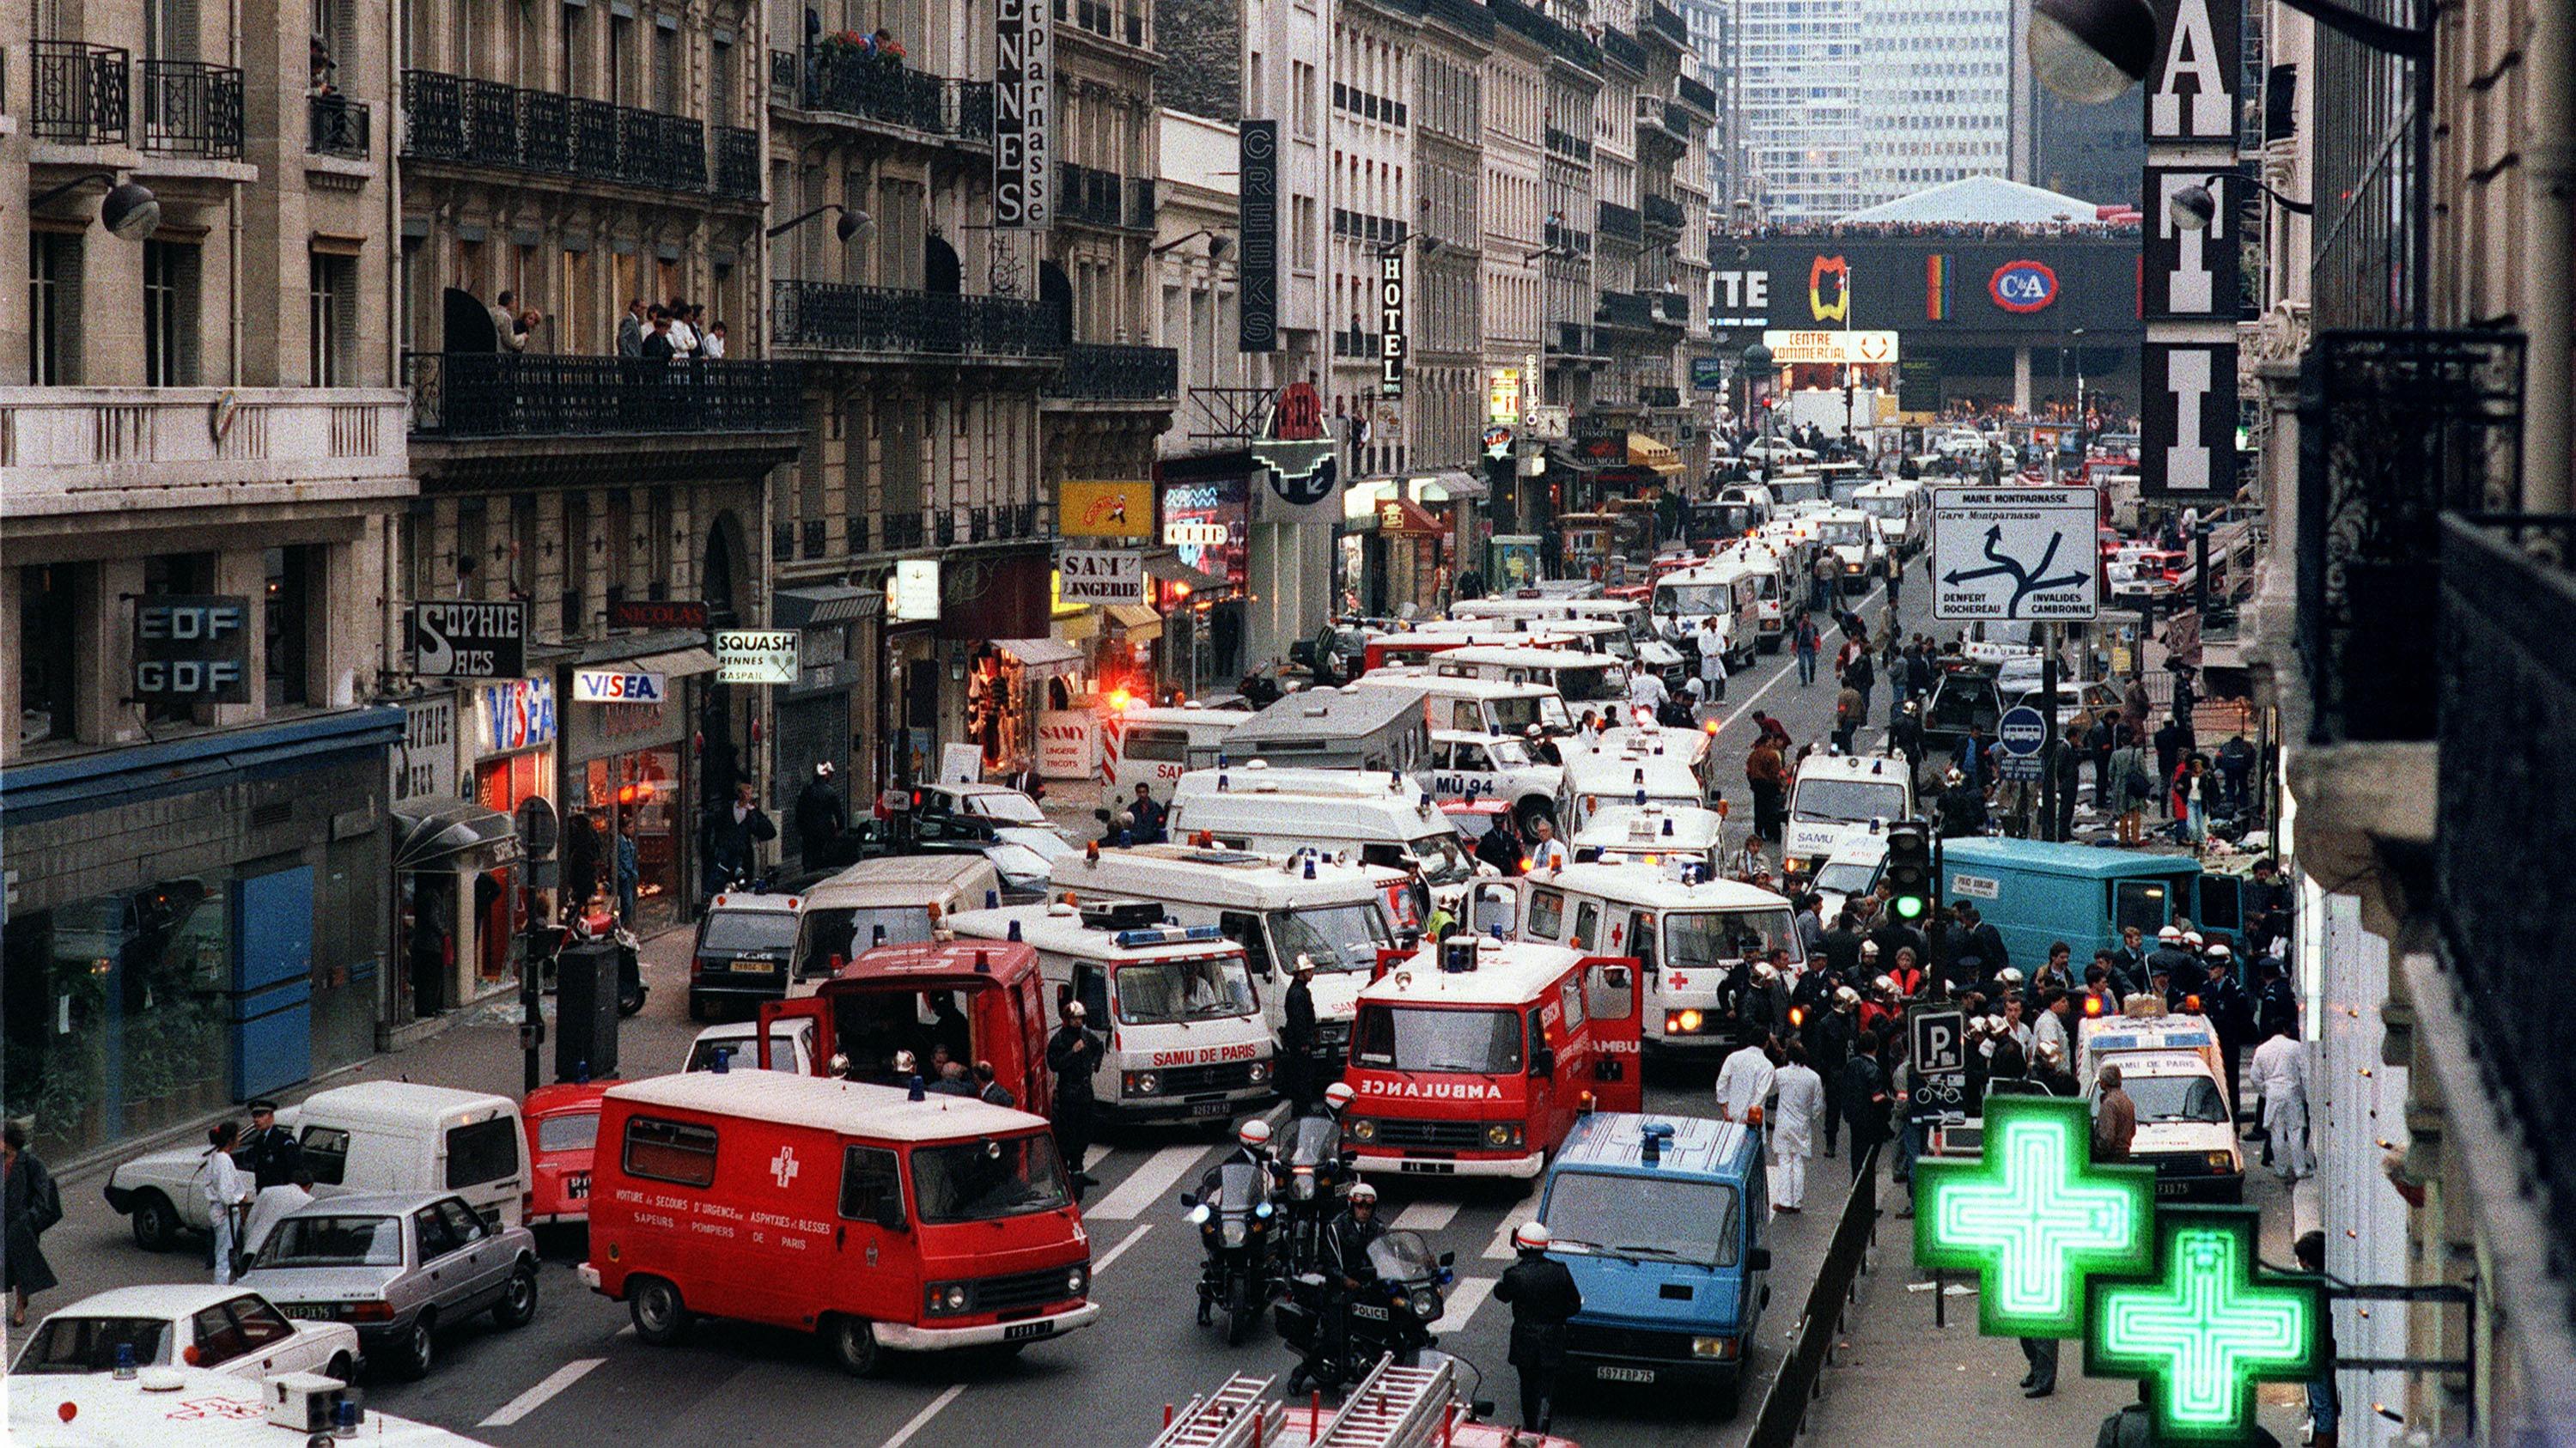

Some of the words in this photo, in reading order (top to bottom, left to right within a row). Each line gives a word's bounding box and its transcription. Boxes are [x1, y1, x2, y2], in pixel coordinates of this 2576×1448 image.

[1244, 130, 1273, 344] CREEKS
[2000, 275, 2046, 298] C&A
[1384, 259, 1401, 381] HOTEL
[1789, 332, 1832, 345] CENTRE
[1772, 346, 1847, 359] COMMERCIAL
[1962, 494, 1992, 504] MAINE
[1994, 494, 2068, 504] MONTPARNASSE
[1938, 510, 1964, 520] Gare
[1969, 510, 2041, 521] Montparnasse
[1064, 581, 1139, 597] LINGERIE
[1944, 593, 1986, 603] DENFERT
[2033, 593, 2082, 603] INVALIDES
[617, 605, 702, 624] NICOLAS
[1944, 604, 2001, 614] ROCHEREAU
[2031, 604, 2092, 614] CAMBRONNE
[140, 606, 240, 639] EDF
[717, 636, 796, 651] SQUASH
[720, 656, 764, 666] RENNES
[138, 660, 240, 694] GDF
[720, 671, 763, 680] RASPAIL
[582, 674, 658, 700] VISEA
[488, 676, 557, 750] VISEA
[1039, 725, 1087, 741] SAMY
[1045, 746, 1079, 755] LINGERIE
[1046, 759, 1079, 769] TRICOTS
[1470, 779, 1493, 795] 94
[1797, 832, 1834, 843] SAMU
[1930, 1025, 1951, 1062] P
[1154, 1049, 1196, 1067] SAMU
[1199, 1047, 1217, 1062] DE
[1221, 1043, 1257, 1061] PARIS
[616, 1189, 643, 1203] VOITURE
[655, 1196, 688, 1211] SECOURS
[694, 1202, 735, 1220] D'URGENCE
[751, 1212, 790, 1228] ASPHYXIES
[634, 1212, 674, 1228] SAPEURS
[691, 1221, 734, 1238] POMPIERS
[752, 1232, 764, 1244] DE
[781, 1237, 807, 1250] PARIS
[1353, 1304, 1388, 1319] POLICE
